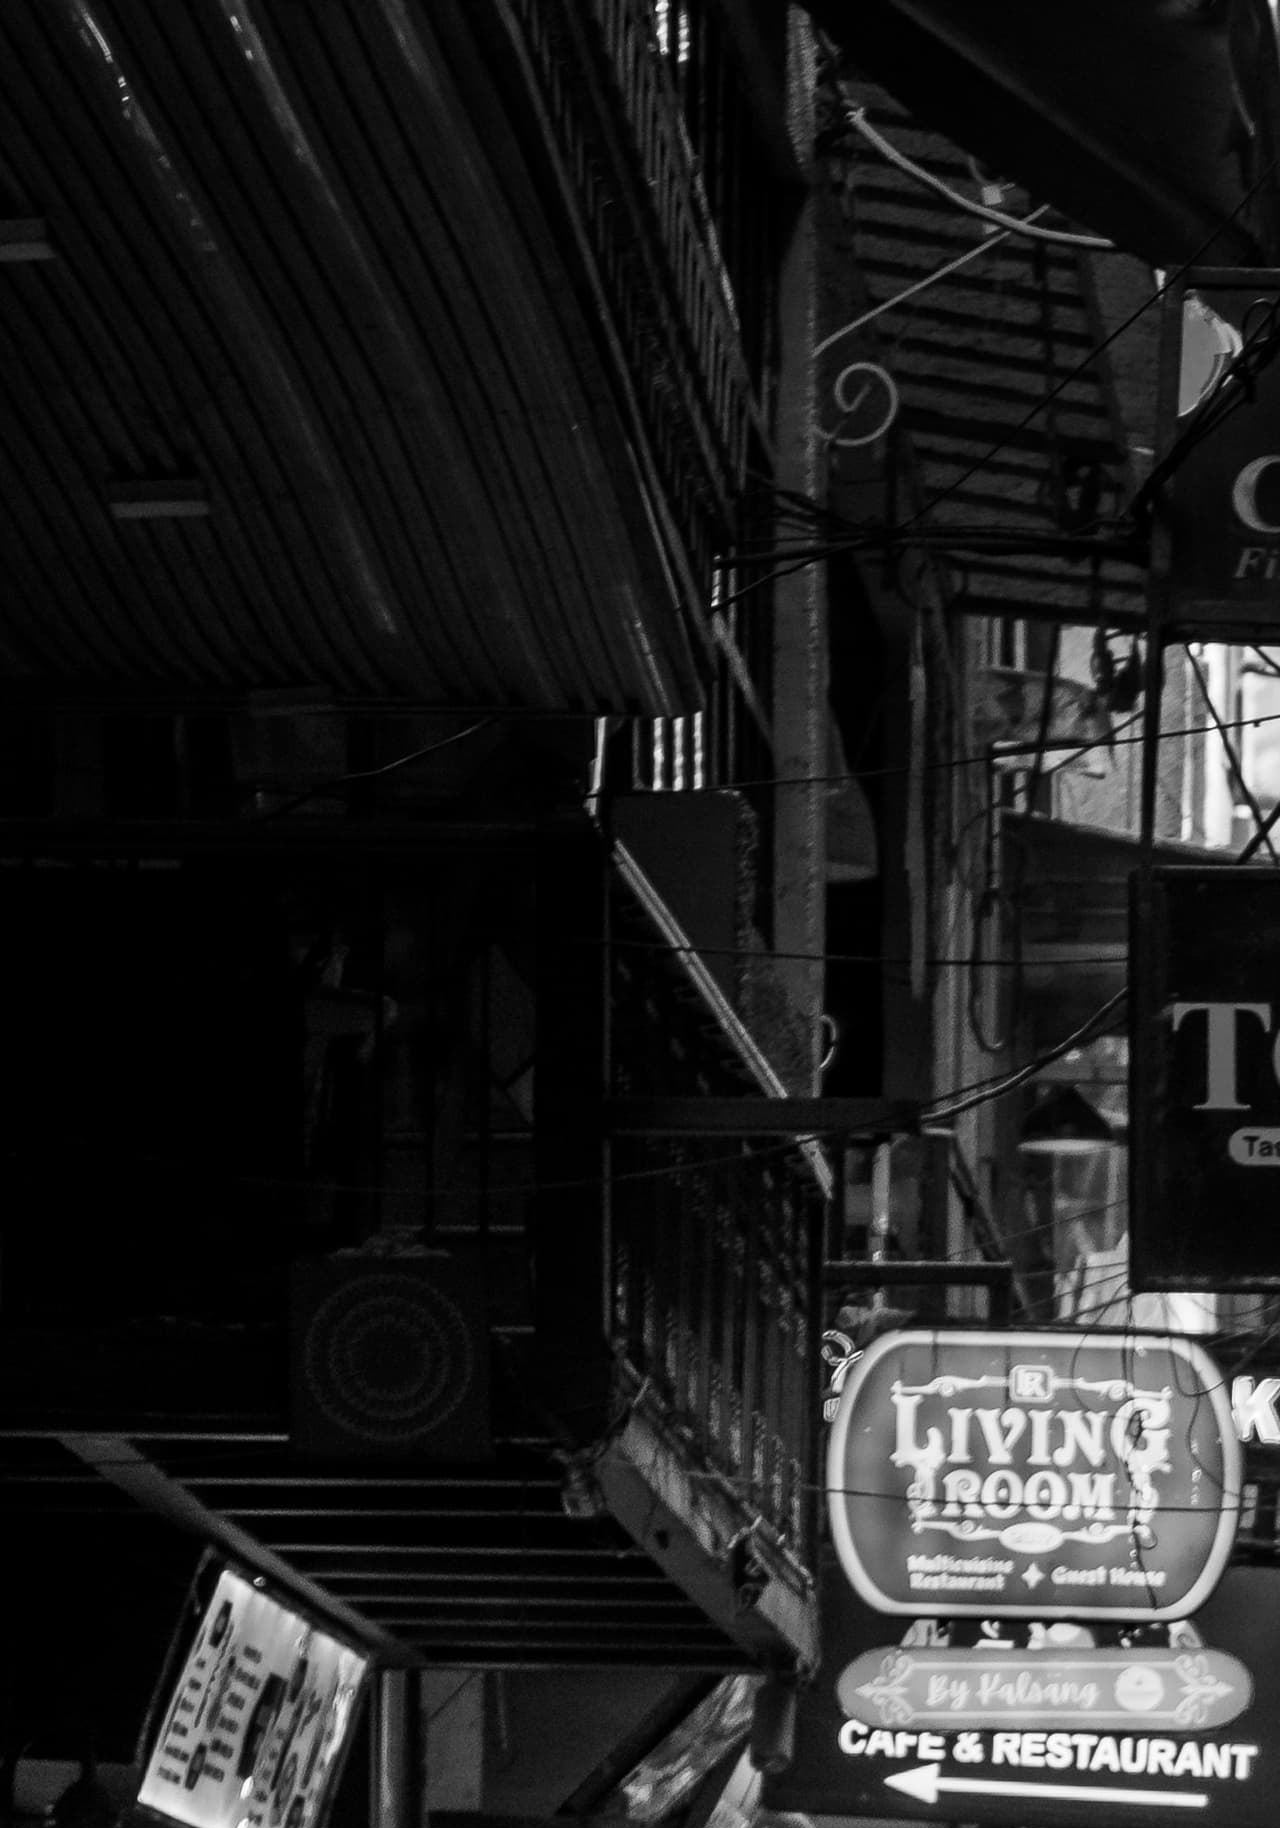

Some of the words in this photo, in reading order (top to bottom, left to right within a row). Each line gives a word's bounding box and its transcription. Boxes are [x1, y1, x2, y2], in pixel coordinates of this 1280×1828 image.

[941, 1469, 1117, 1521] ROOM
[925, 1672, 970, 1711] By
[953, 1732, 984, 1763] &
[992, 1731, 1259, 1781] RESTAURANT
